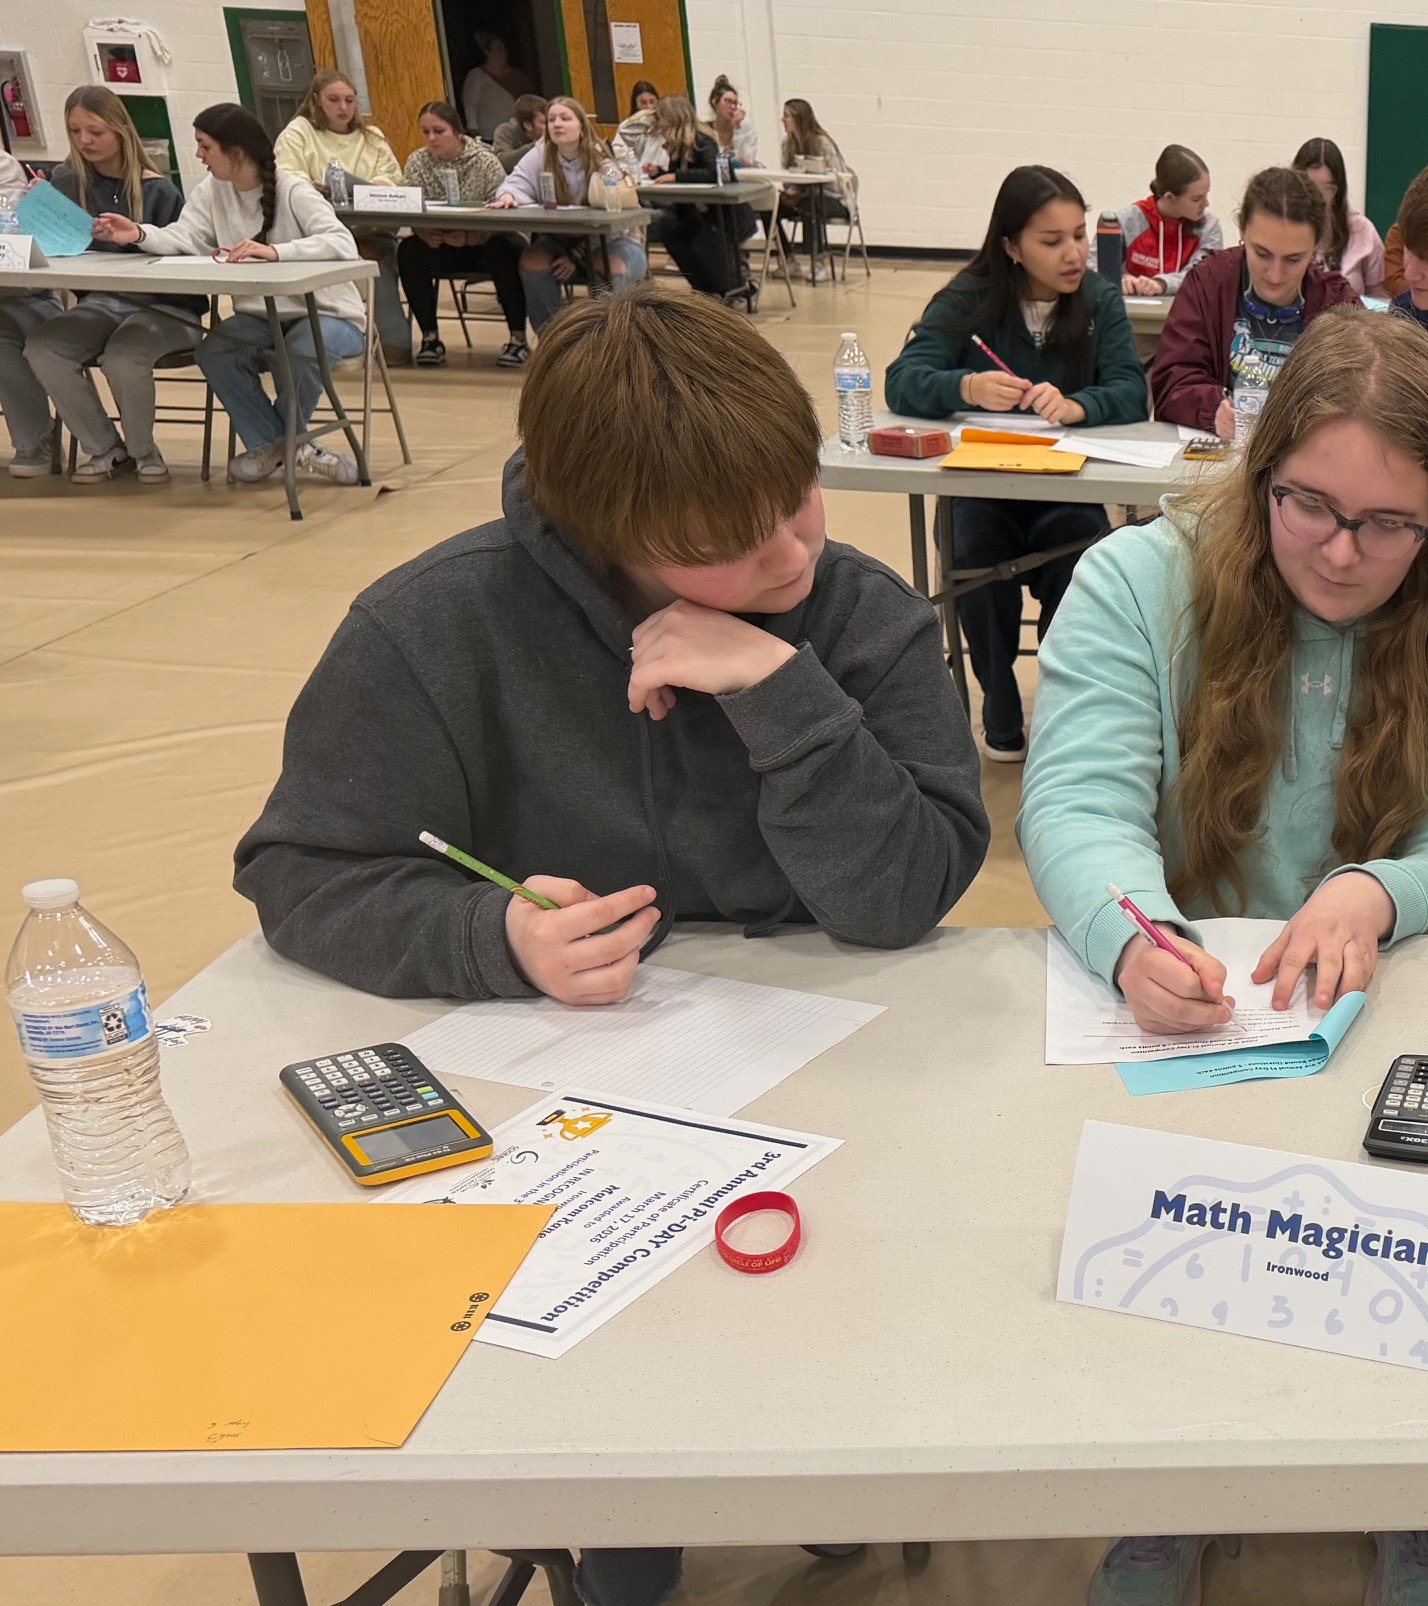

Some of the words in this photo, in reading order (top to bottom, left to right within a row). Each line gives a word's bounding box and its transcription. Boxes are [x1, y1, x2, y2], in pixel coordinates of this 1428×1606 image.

[548, 1149, 600, 1182] Participation
[582, 1167, 596, 1177] IN
[756, 1151, 782, 1172] 3rd
[520, 1186, 538, 1200] the
[538, 1179, 549, 1190] in
[660, 1178, 709, 1214] Certificate
[707, 1168, 759, 1208] Annual
[566, 1184, 621, 1218] Malcom
[595, 1196, 632, 1223] Awarded
[636, 1191, 667, 1214] March
[1151, 1189, 1252, 1235] Math
[538, 1213, 574, 1240] Kane
[584, 1218, 596, 1229] to
[650, 1210, 662, 1222] of
[654, 1202, 709, 1250] Pi-DAY
[583, 1216, 652, 1266] Participation
[589, 1224, 619, 1244] 2026
[540, 1248, 652, 1322] Competition
[1266, 1261, 1329, 1282] Ironwood
